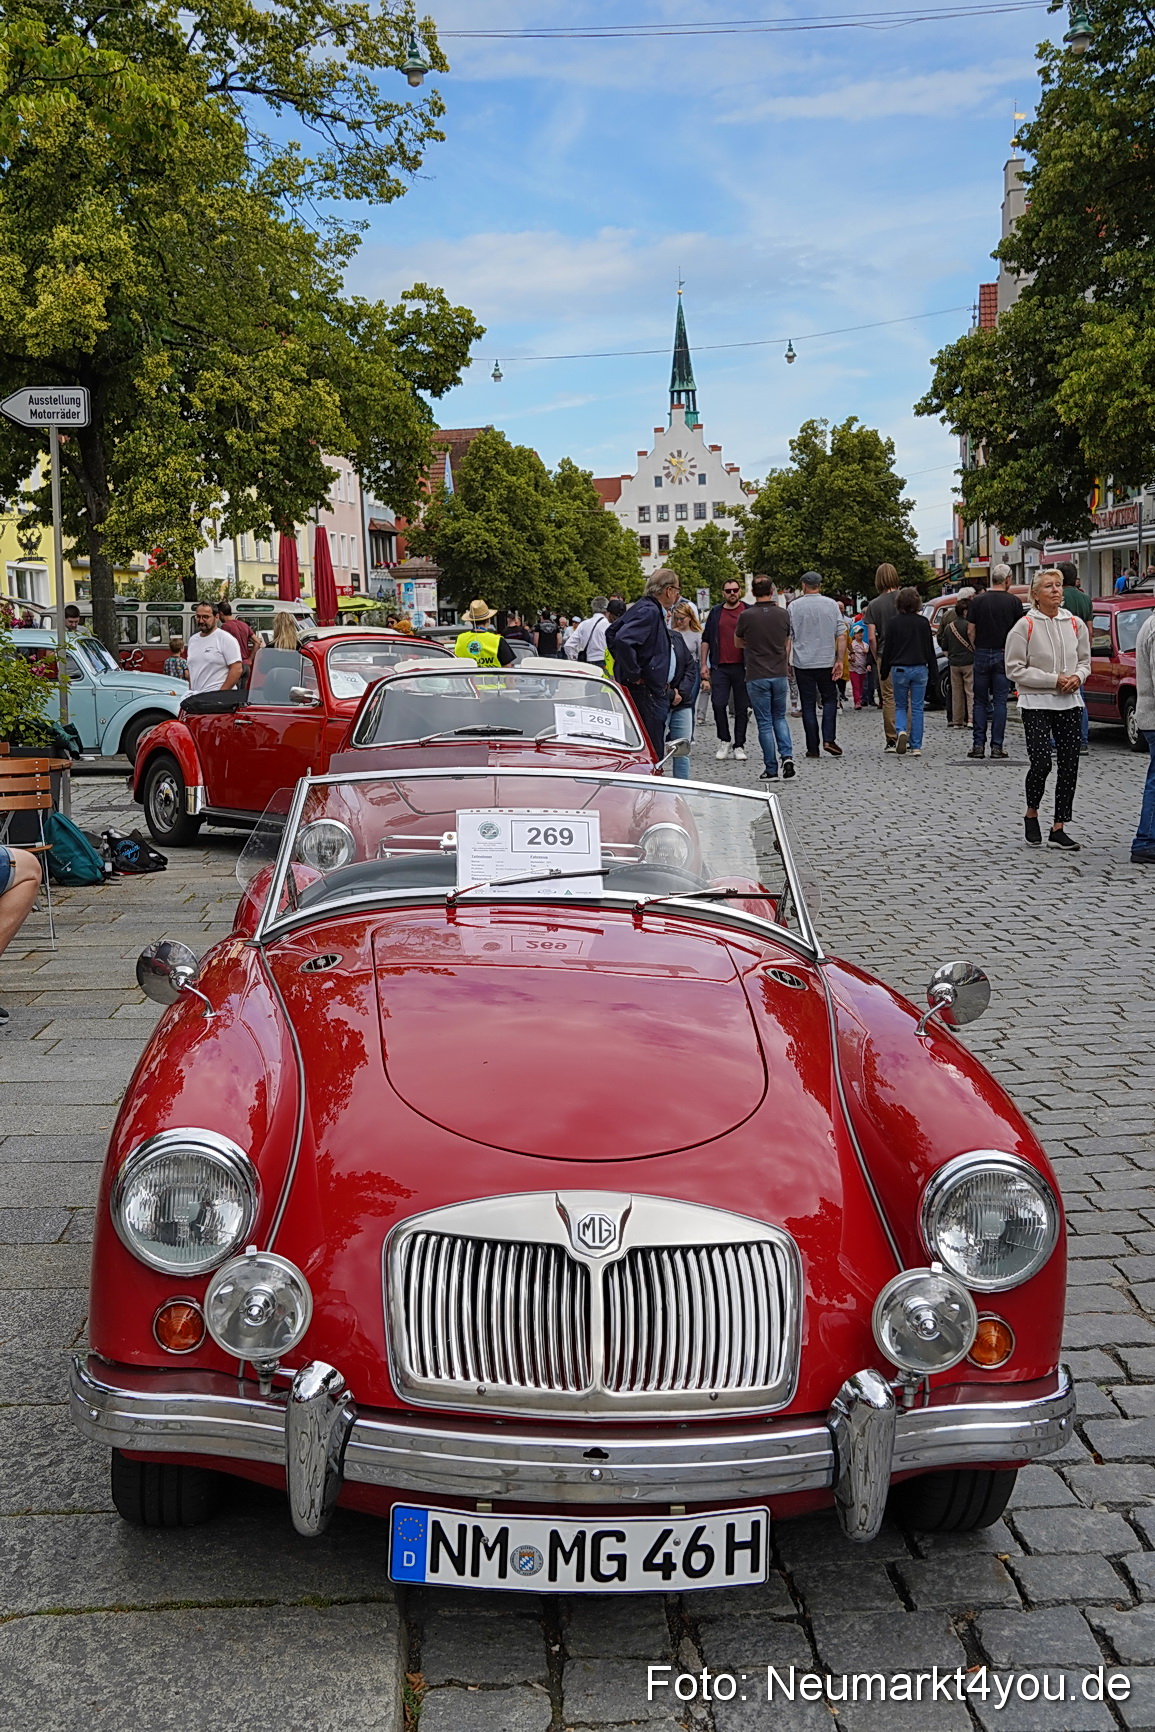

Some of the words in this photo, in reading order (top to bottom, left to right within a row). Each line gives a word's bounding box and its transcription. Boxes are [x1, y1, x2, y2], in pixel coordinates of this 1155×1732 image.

[28, 394, 81, 408] Ausstellung
[30, 408, 81, 420] Motorräder
[588, 714, 612, 726] 265
[527, 827, 574, 846] 269
[582, 1217, 612, 1244] MG
[403, 1550, 416, 1567] D
[429, 1519, 509, 1579] NM
[548, 1529, 627, 1583] MG
[642, 1519, 762, 1581] 46H
